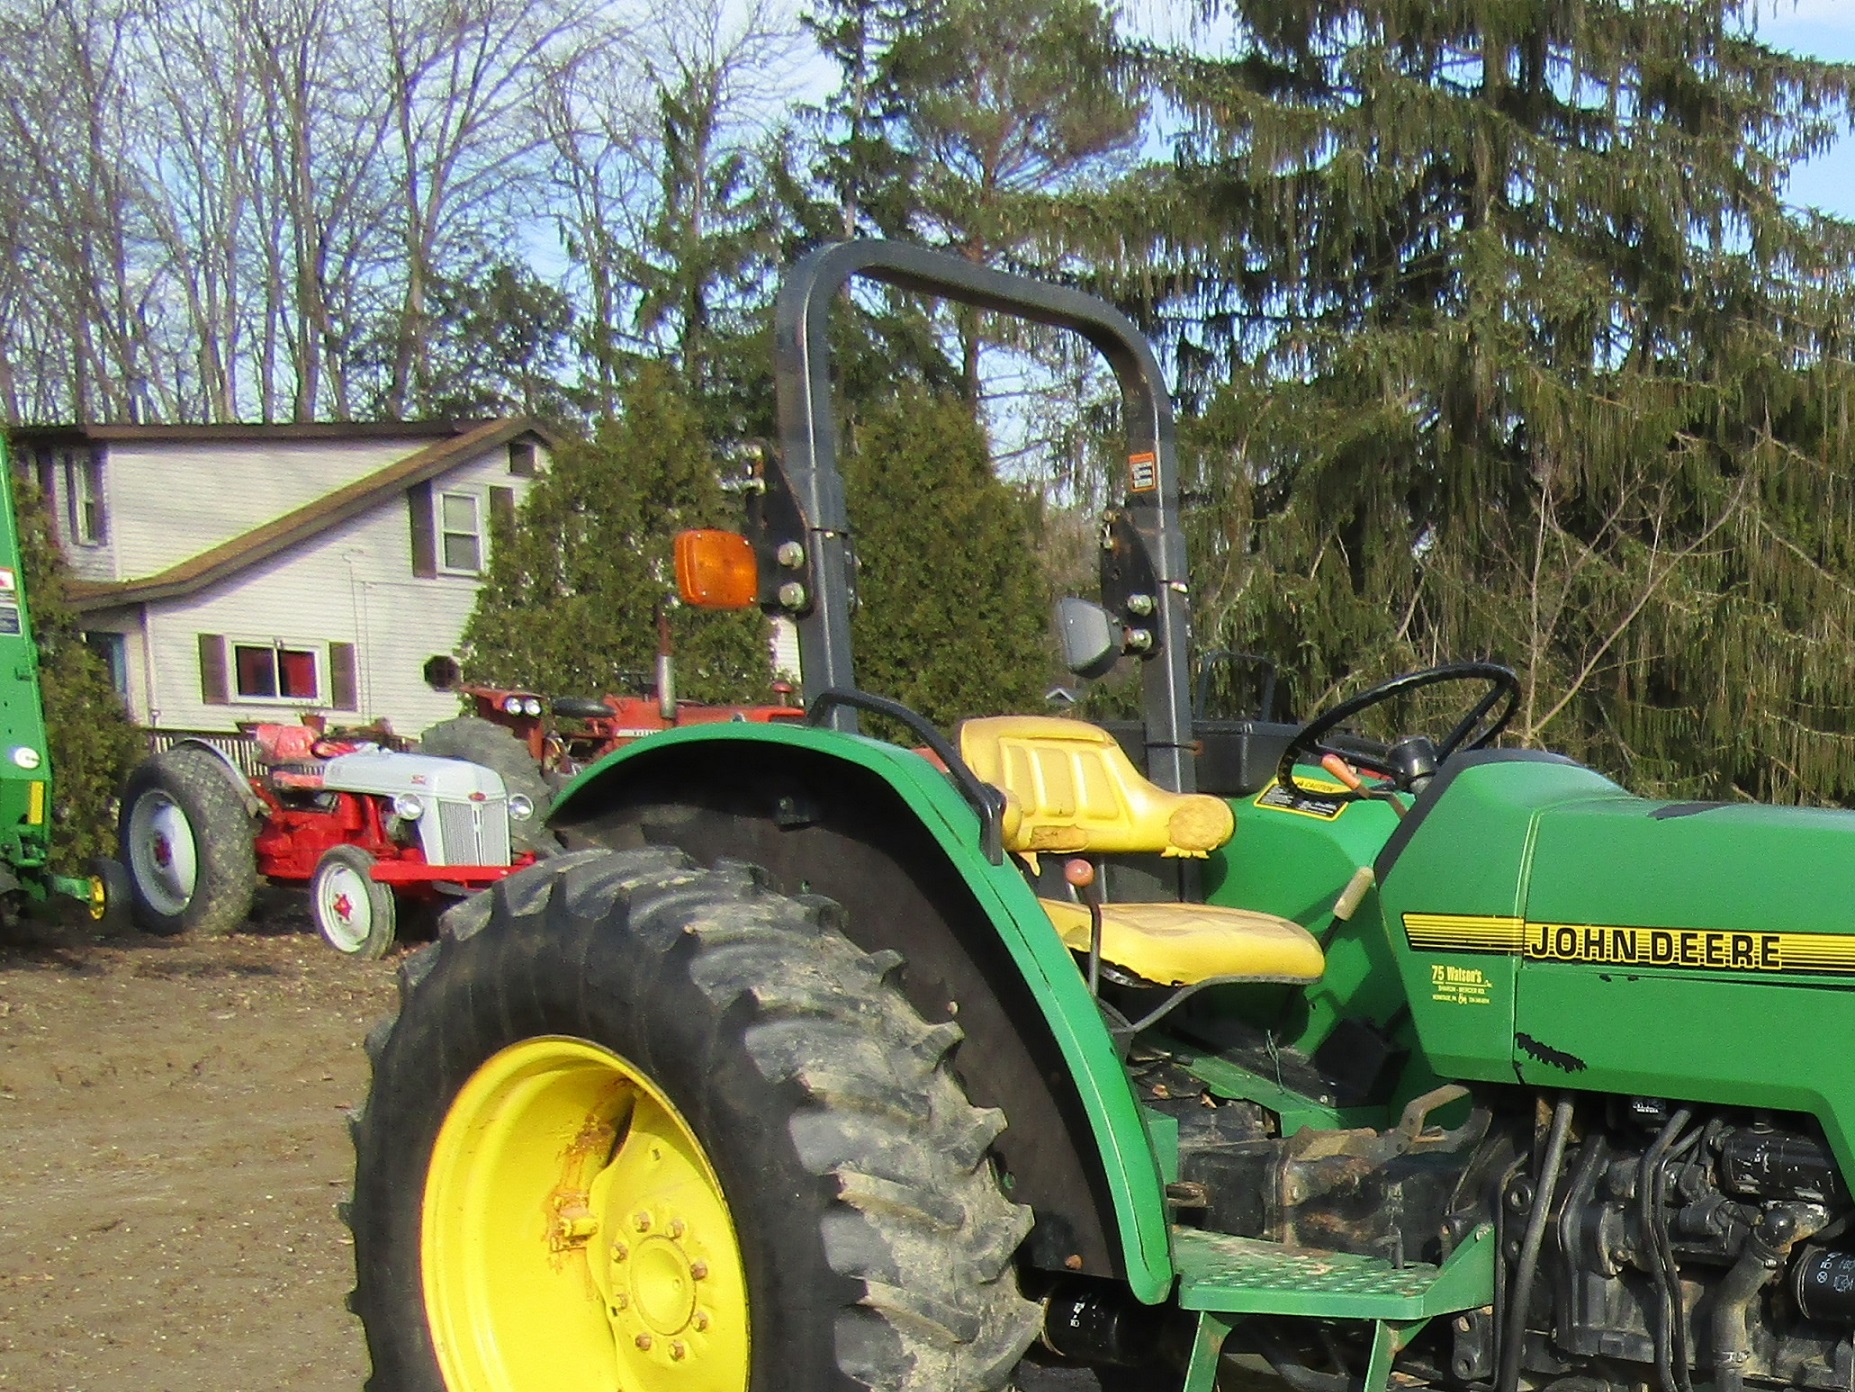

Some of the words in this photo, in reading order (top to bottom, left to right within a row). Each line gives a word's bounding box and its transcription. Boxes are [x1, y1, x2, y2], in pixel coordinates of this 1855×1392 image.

[1531, 926, 1637, 962] JOHN
[1650, 931, 1781, 970] DEERE
[1432, 965, 1444, 981] 75
[1446, 966, 1482, 984] Watson's
